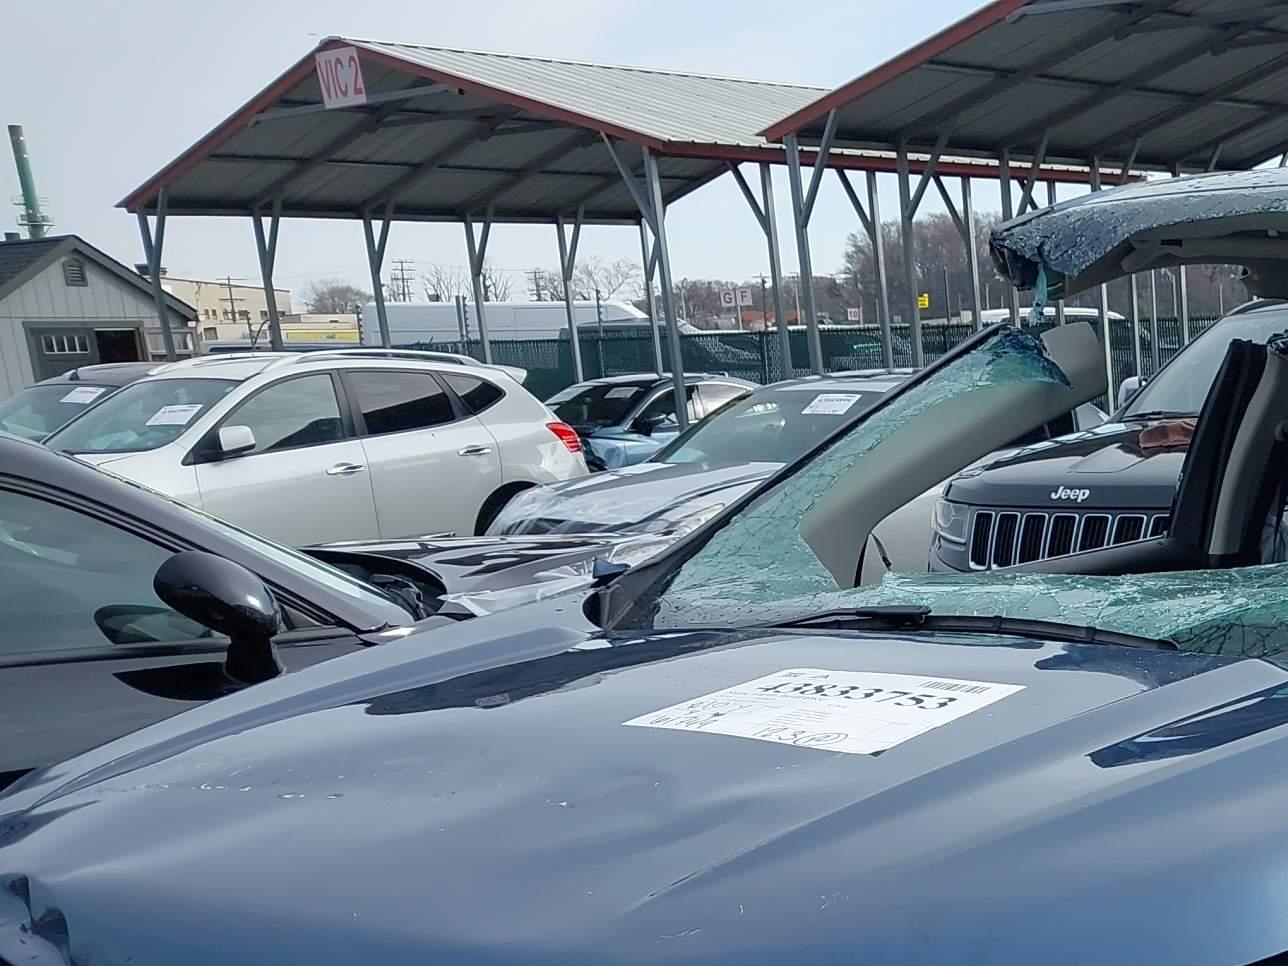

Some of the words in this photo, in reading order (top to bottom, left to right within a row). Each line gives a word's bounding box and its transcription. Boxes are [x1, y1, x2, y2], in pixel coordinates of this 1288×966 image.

[317, 57, 348, 100] VIC
[348, 54, 364, 97] 2
[722, 292, 734, 304] G
[740, 291, 748, 302] F
[1051, 485, 1090, 503] Jeep
[757, 681, 959, 710] 43833753
